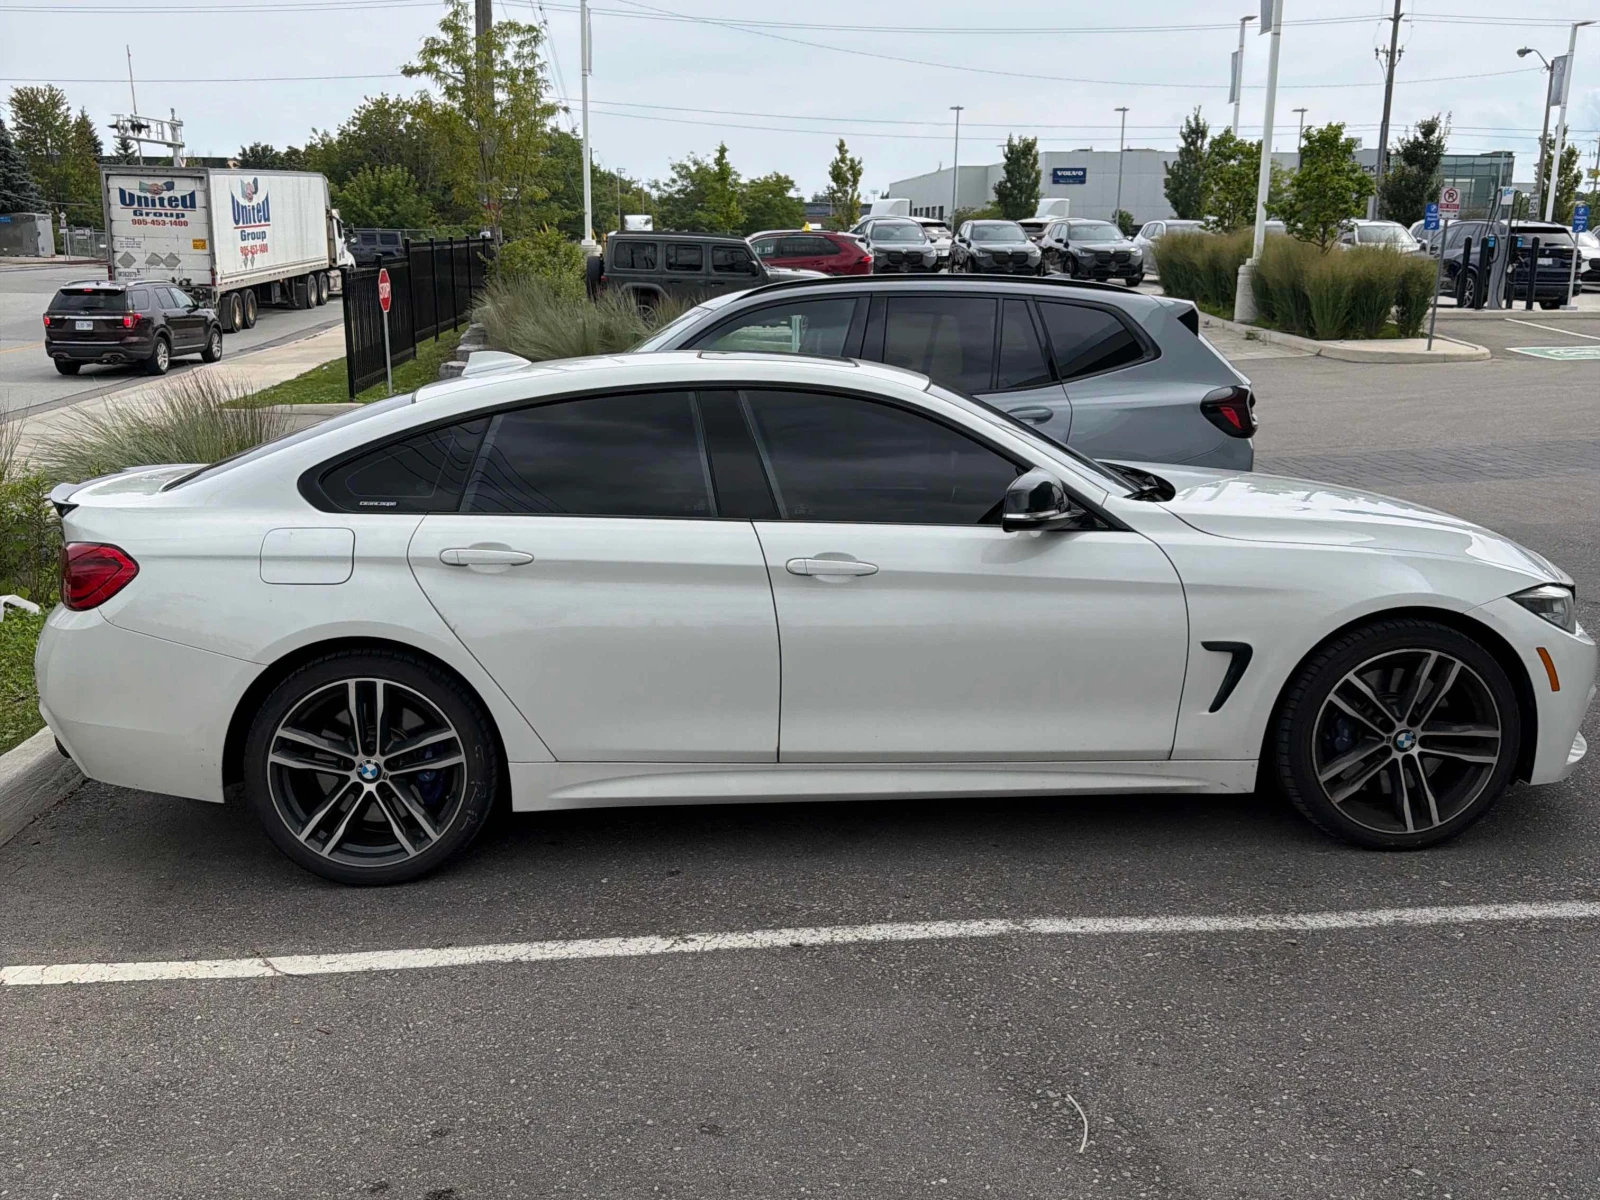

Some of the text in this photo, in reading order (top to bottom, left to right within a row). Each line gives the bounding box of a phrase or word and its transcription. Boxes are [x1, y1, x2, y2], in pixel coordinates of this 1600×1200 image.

[119, 187, 197, 209] United
[133, 210, 185, 219] Group
[231, 190, 270, 226] United
[131, 219, 189, 227] 905-453-1400
[240, 230, 266, 241] Group
[380, 283, 390, 298] STOP
